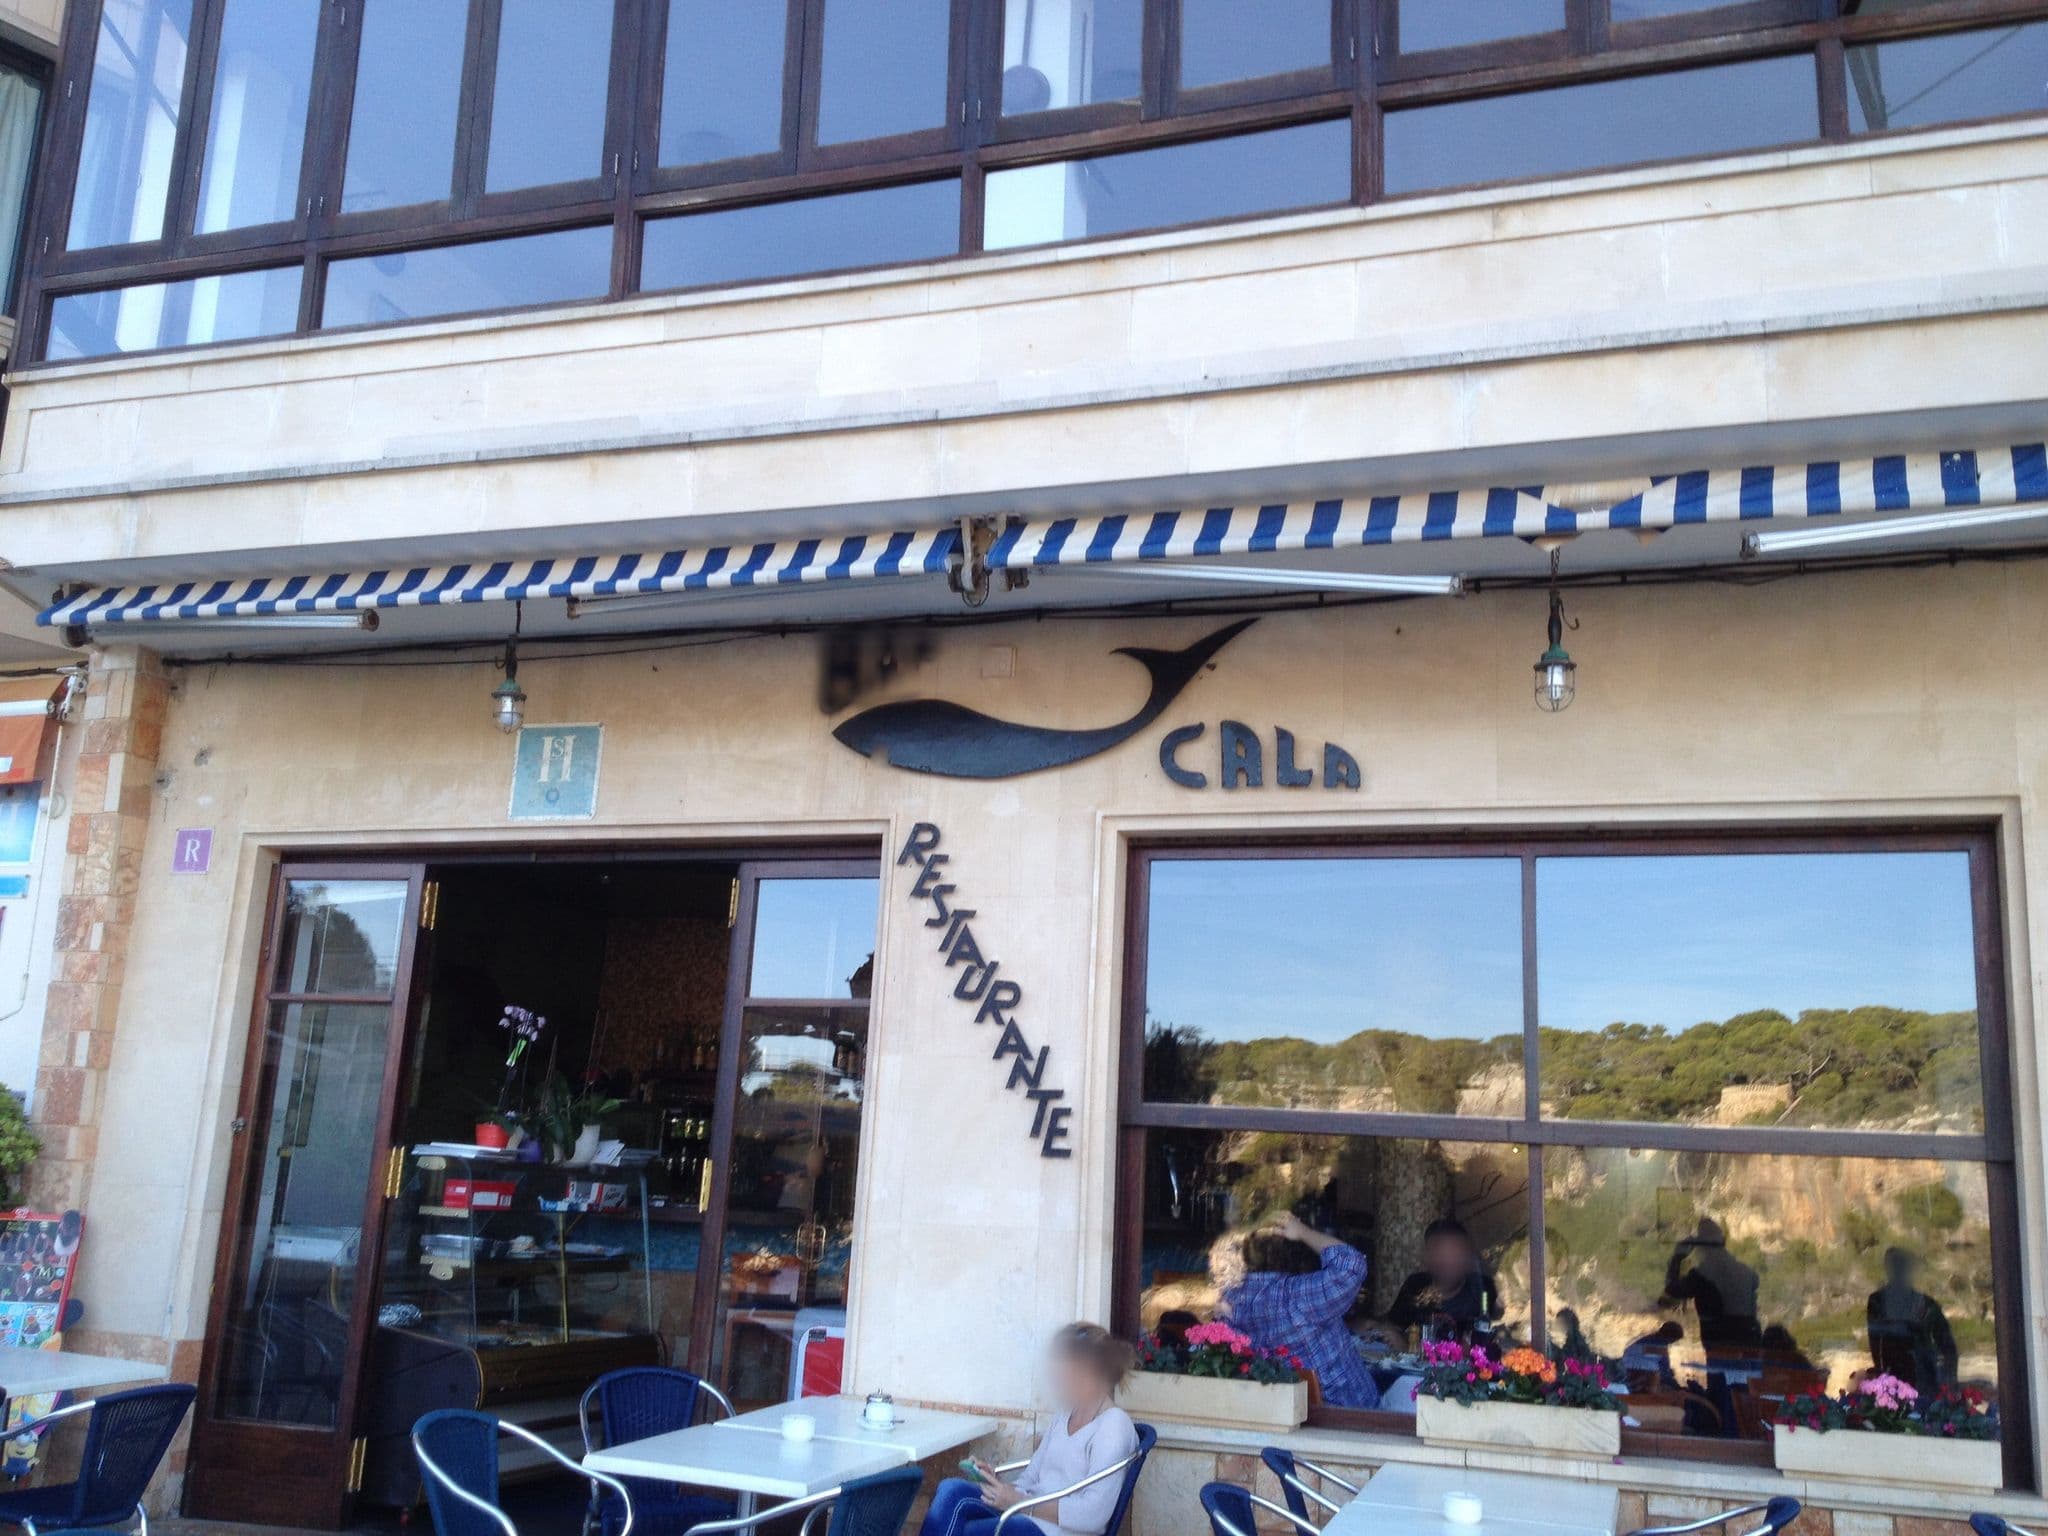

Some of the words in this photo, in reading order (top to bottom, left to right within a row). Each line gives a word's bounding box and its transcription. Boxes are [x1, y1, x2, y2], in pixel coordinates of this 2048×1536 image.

[1159, 719, 1361, 790] CALA
[184, 838, 201, 862] R
[897, 822, 1072, 1158] RESTAURANTE
